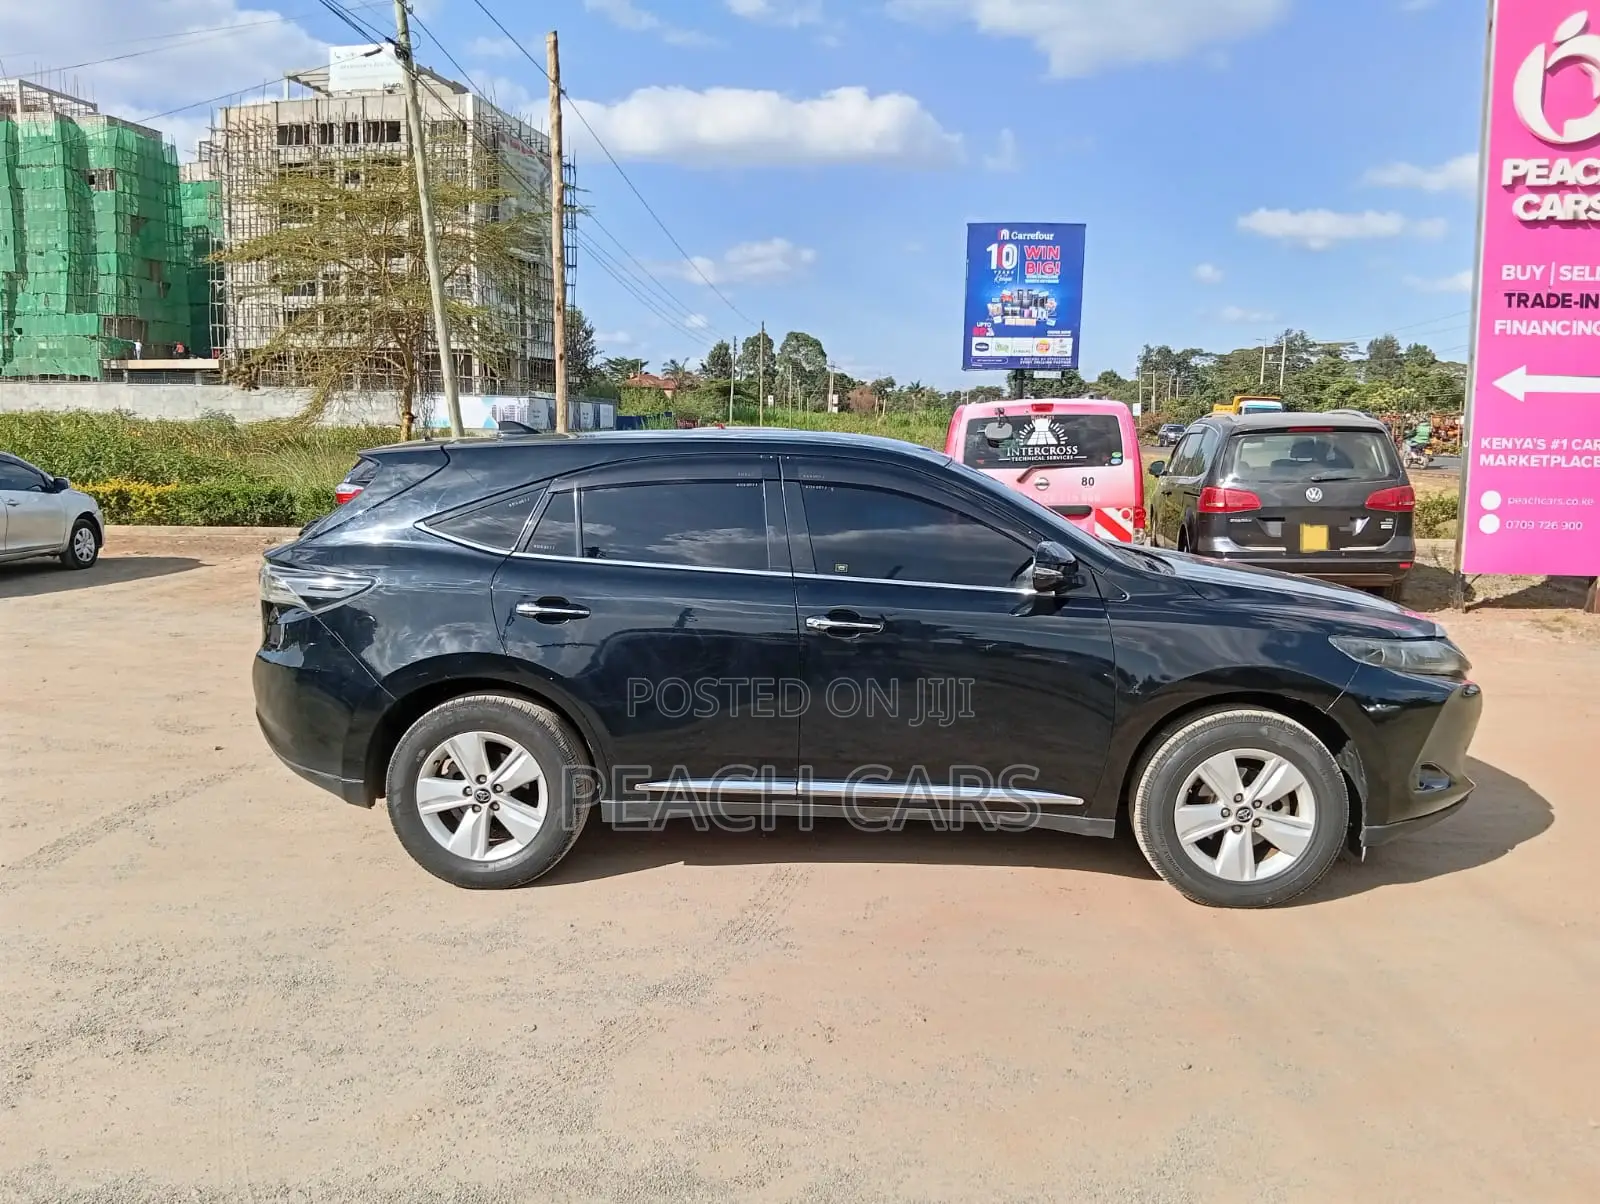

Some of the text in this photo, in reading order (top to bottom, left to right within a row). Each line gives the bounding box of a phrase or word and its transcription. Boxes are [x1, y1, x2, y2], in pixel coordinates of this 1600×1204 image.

[1512, 193, 1600, 221] CARS
[1010, 231, 1055, 241] Carrefour
[986, 242, 1018, 270] 10
[1023, 245, 1061, 260] WIN
[1025, 260, 1062, 276] BIG!
[1501, 264, 1546, 281] BUY
[1504, 292, 1600, 309] TRADE-IN
[1007, 445, 1079, 457] INTERCROSS
[1480, 437, 1600, 451] KENYA'S #1 CAR
[1479, 454, 1600, 469] MARKETPLACE
[1081, 476, 1095, 487] 80
[1505, 520, 1583, 531] 0709 726 900
